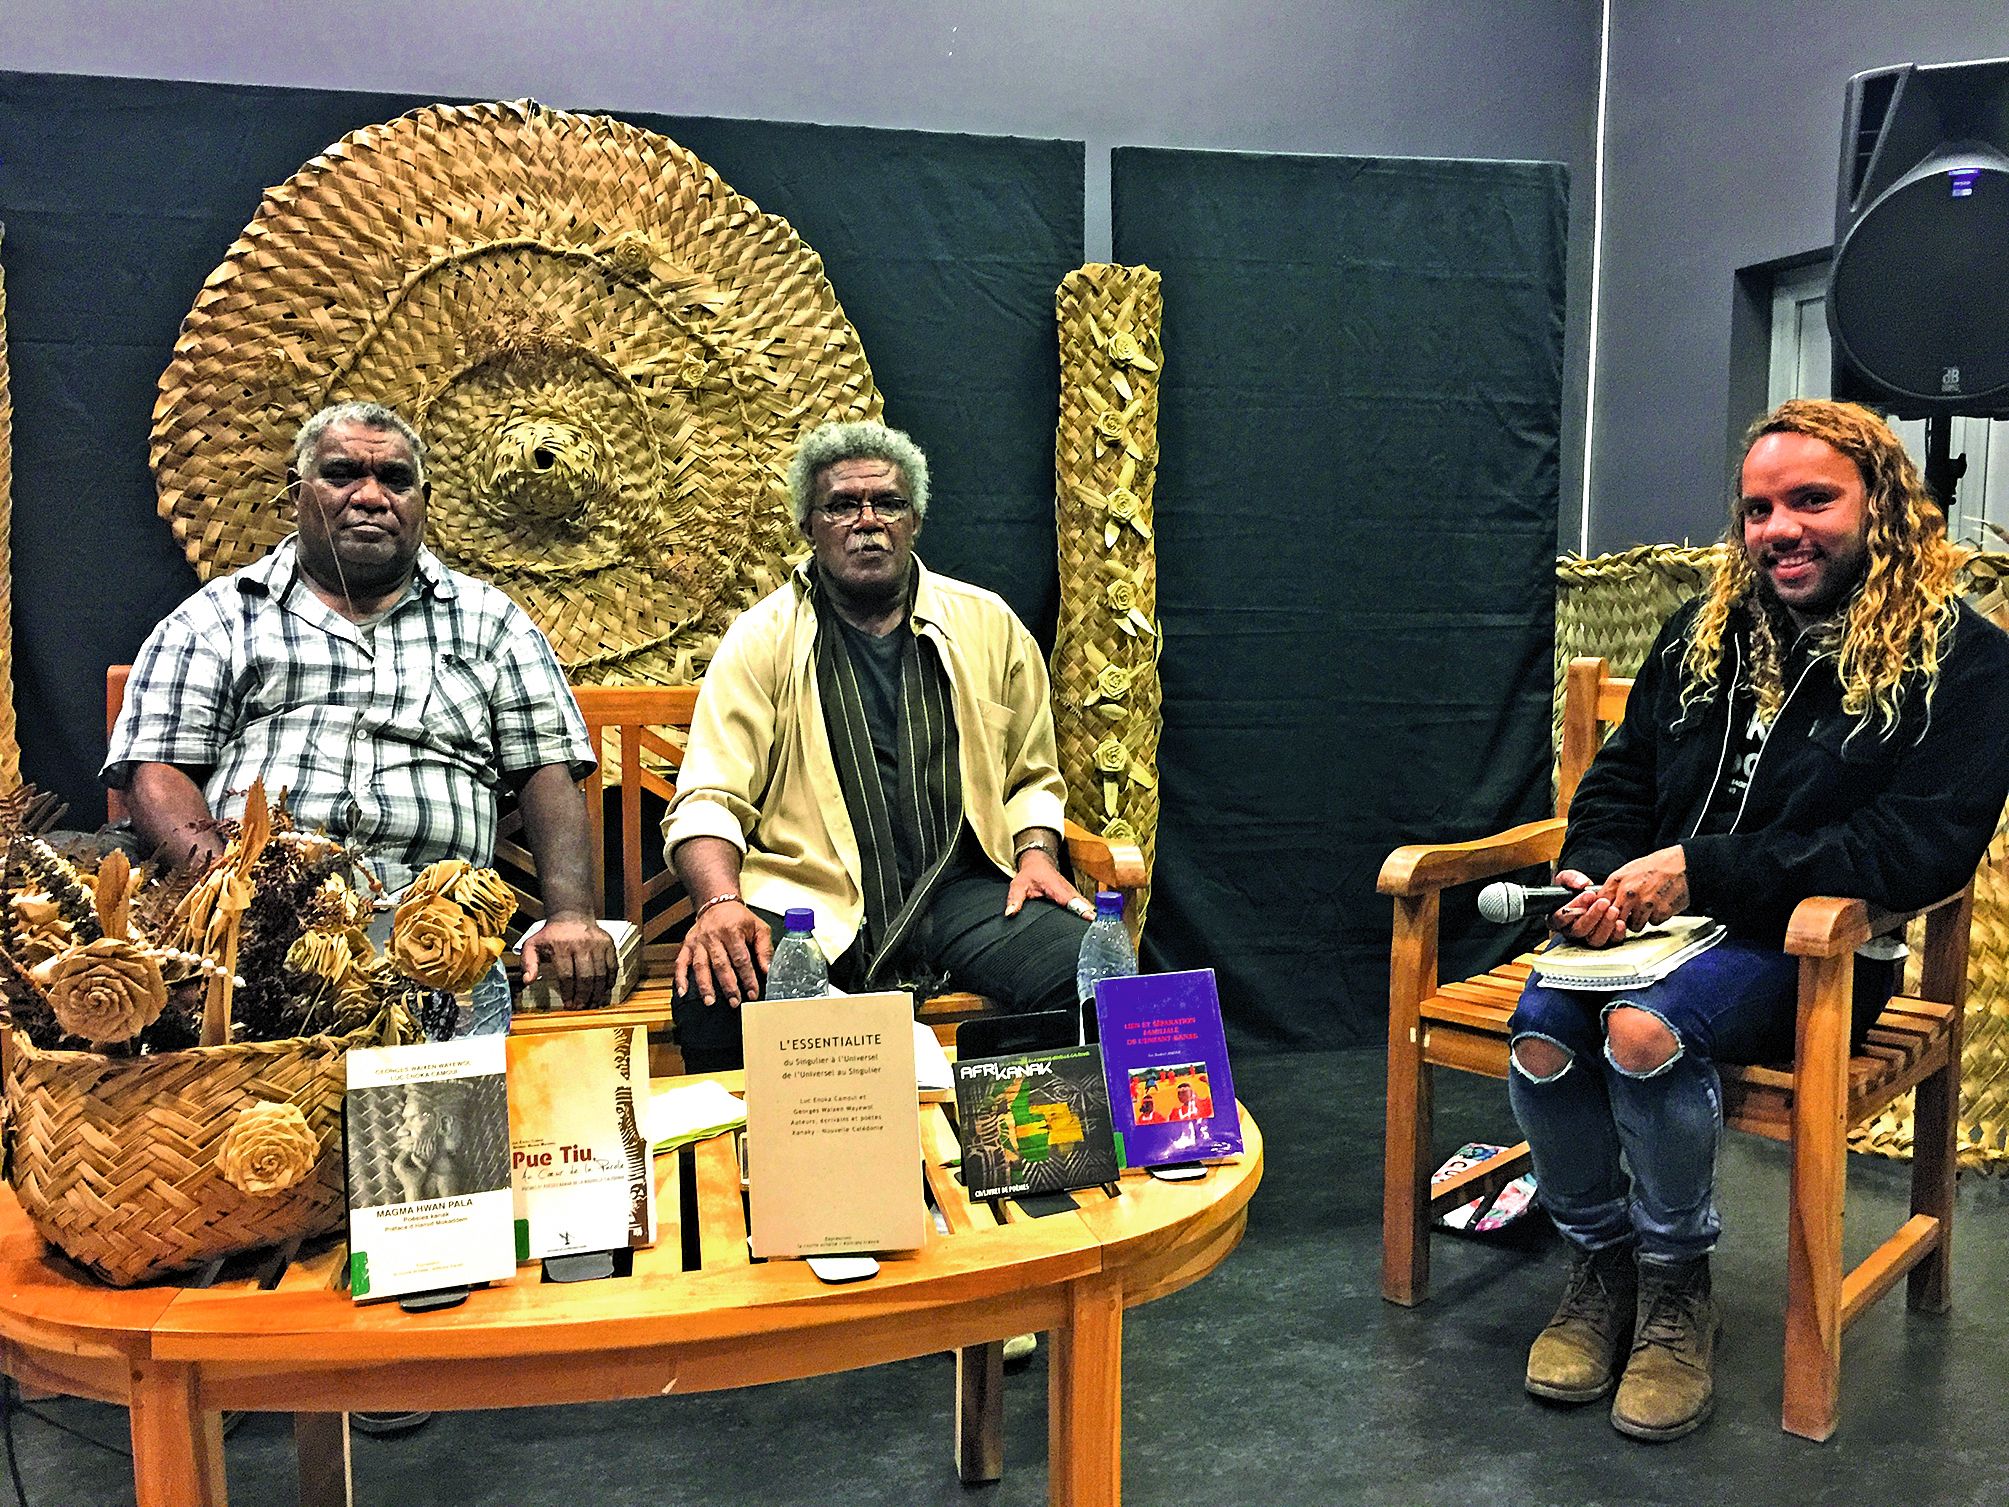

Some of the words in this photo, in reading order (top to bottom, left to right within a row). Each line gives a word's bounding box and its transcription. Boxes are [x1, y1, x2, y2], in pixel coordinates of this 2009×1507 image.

[779, 1033, 882, 1051] L'ESSENTIALITE
[783, 1059, 794, 1067] du
[795, 1057, 830, 1067] Singulier
[838, 1053, 879, 1063] l'Universel
[782, 1071, 792, 1079] de
[794, 1069, 835, 1078] l'Universel
[848, 1066, 882, 1076] Singulier
[512, 1151, 552, 1170] Pue
[376, 1206, 414, 1218] MAGMA
[416, 1202, 446, 1213] HWAN
[448, 1198, 473, 1209] PALA
